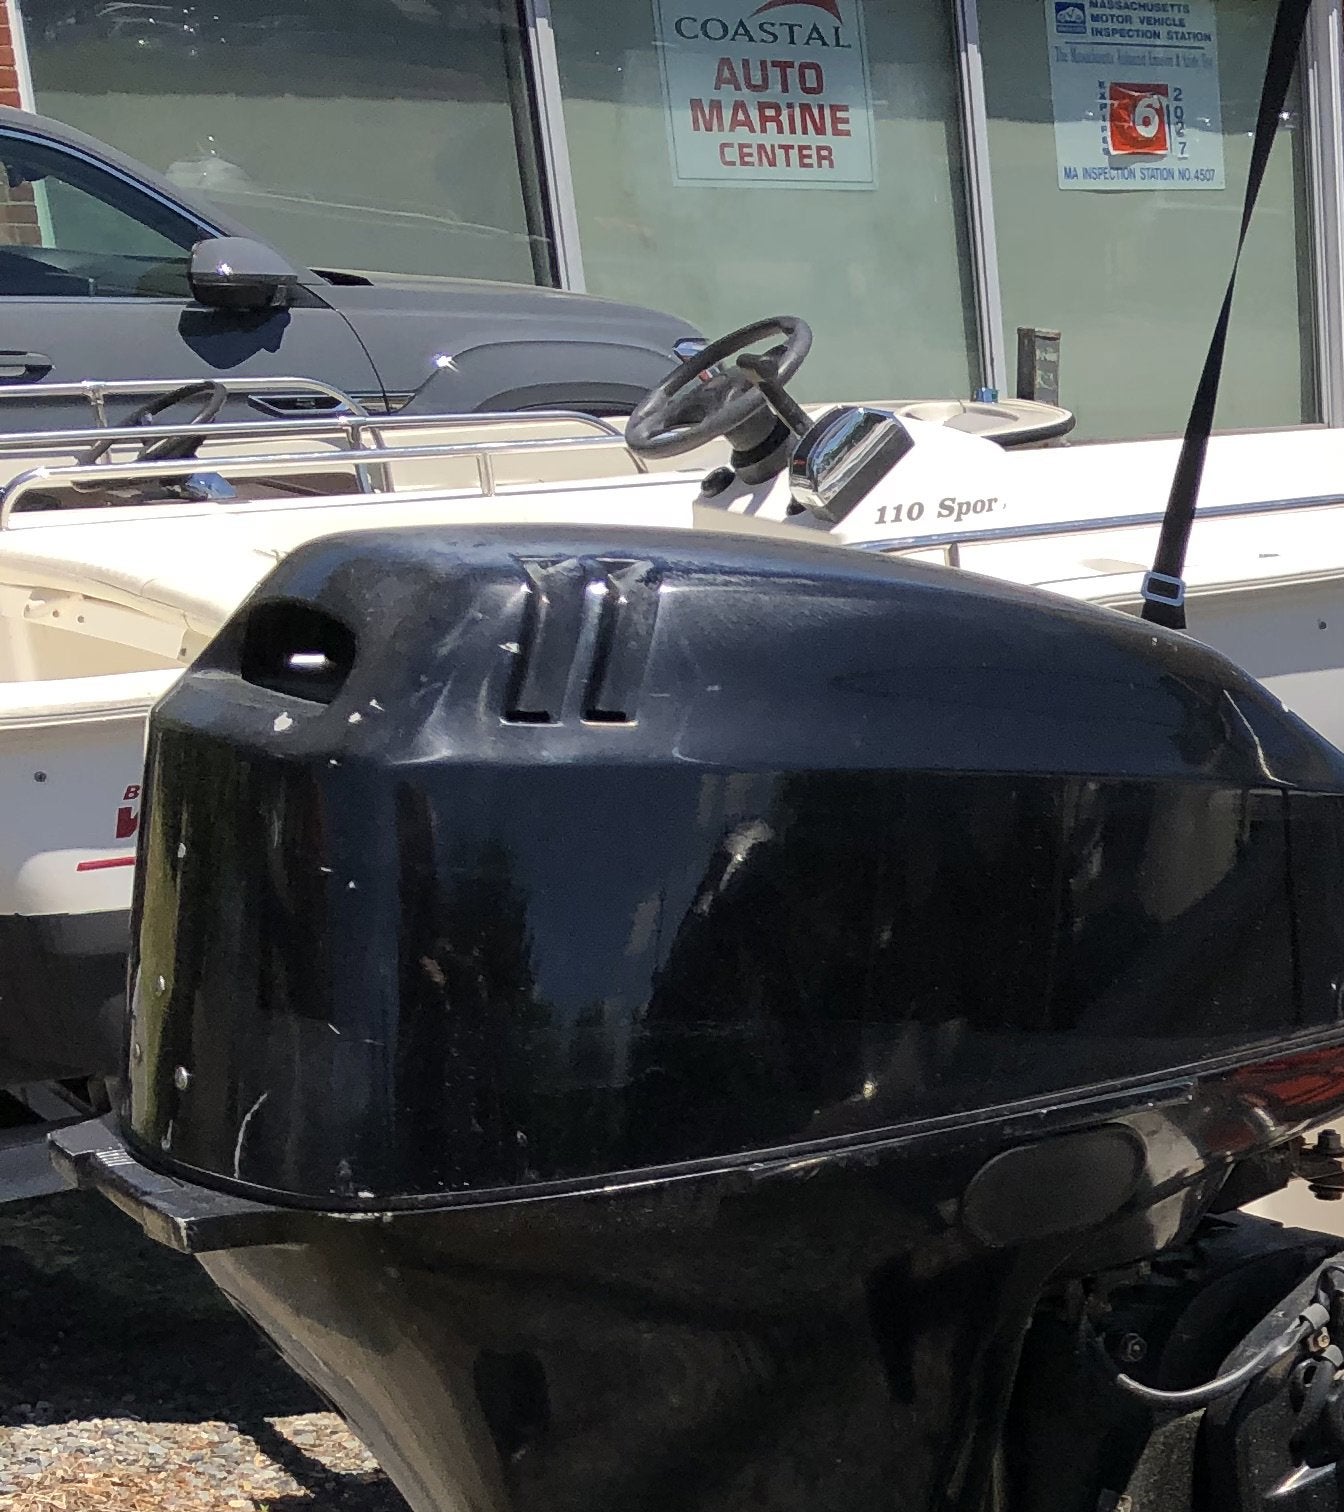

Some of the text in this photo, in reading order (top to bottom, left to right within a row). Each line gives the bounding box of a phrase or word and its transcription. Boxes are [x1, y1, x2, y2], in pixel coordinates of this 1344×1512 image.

[674, 17, 852, 48] COASTAL
[1091, 14, 1186, 27] MOTOR VEHICLE
[1091, 28, 1161, 40] INSPECTION
[1167, 30, 1212, 42] STATION
[714, 57, 824, 95] AUTO
[718, 142, 835, 169] CENTER
[1063, 166, 1079, 180] MA
[1082, 166, 1136, 181] INSPECTION
[1139, 168, 1175, 181] STATION
[874, 497, 1007, 525] 110 Spor
